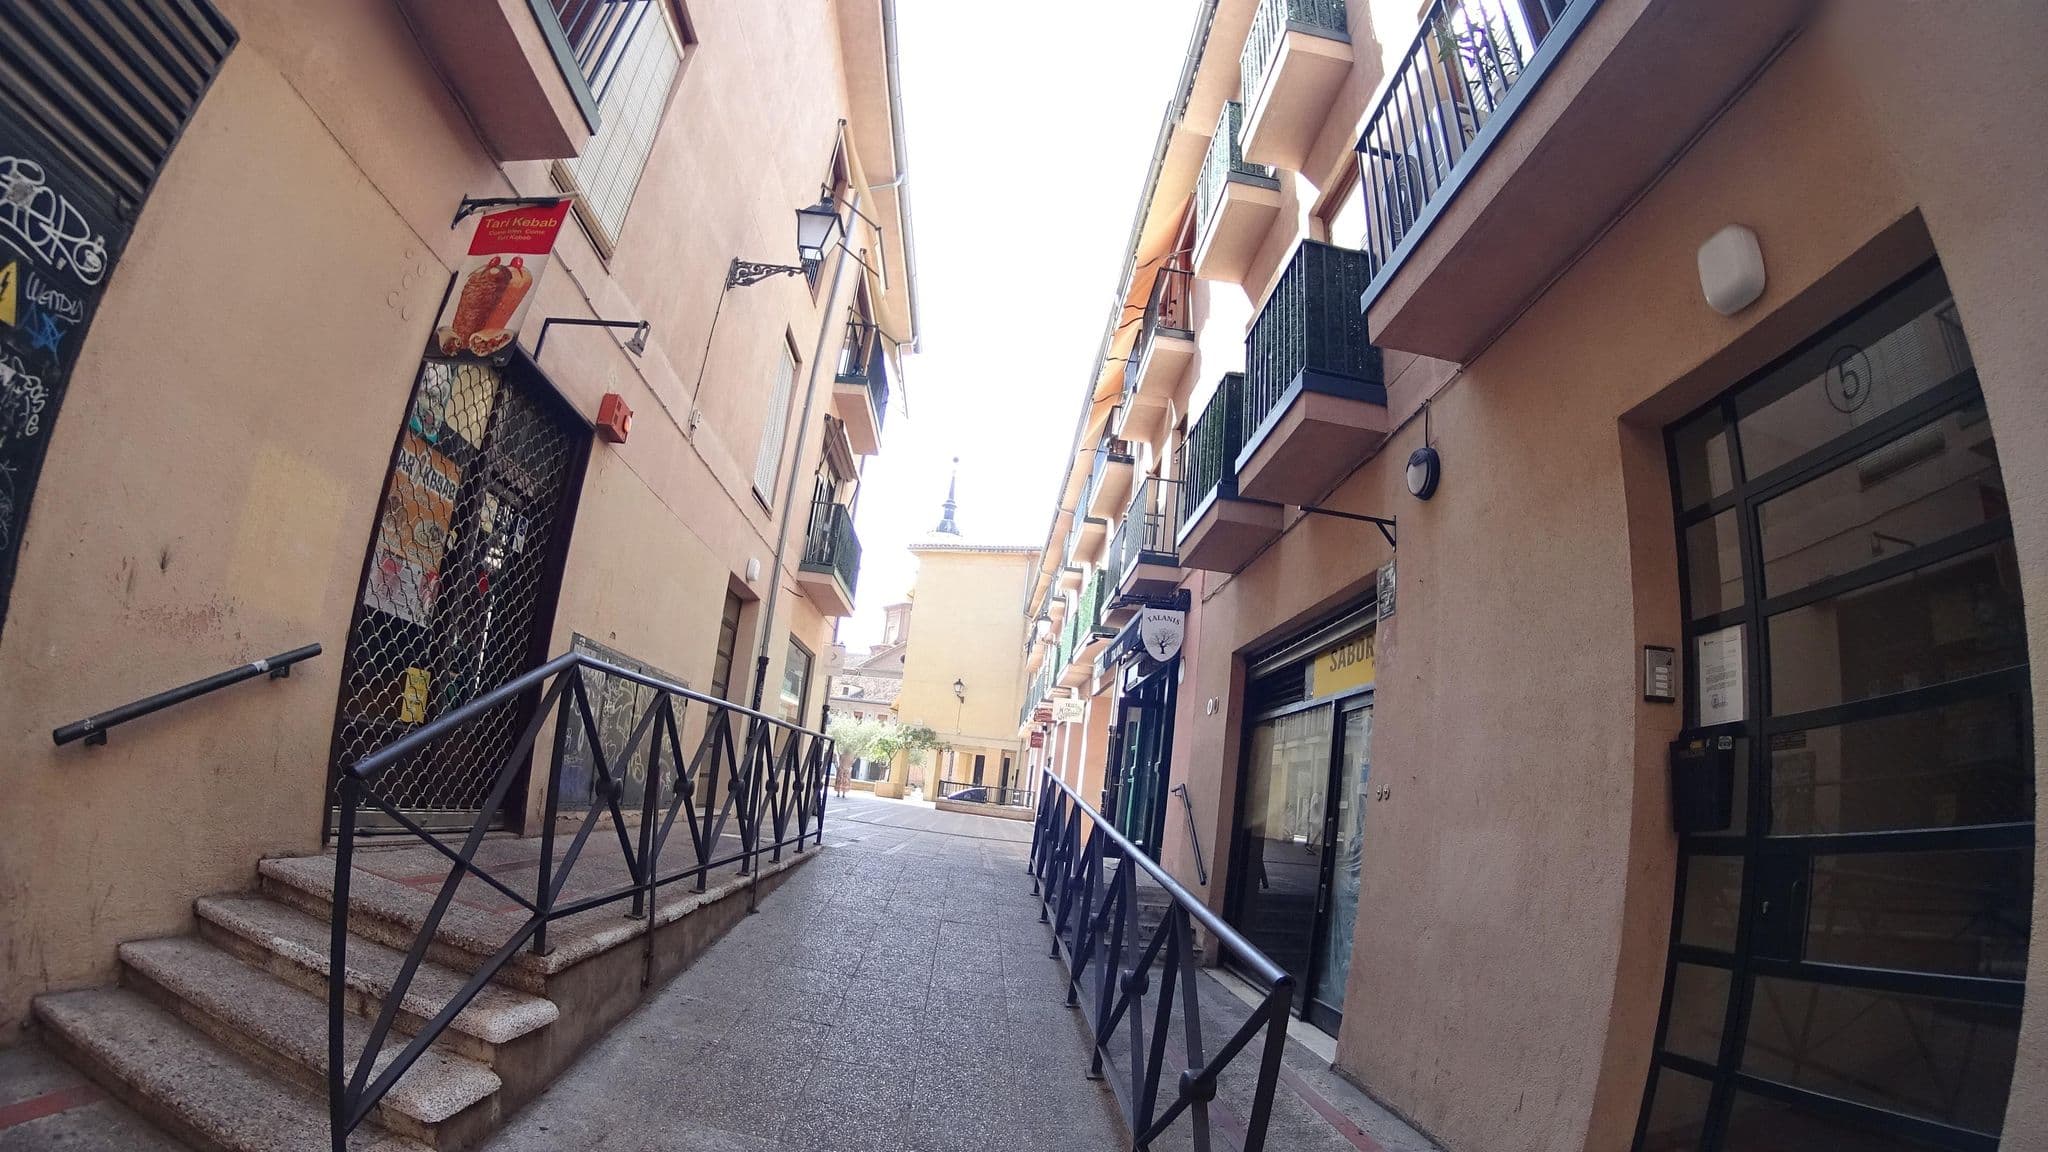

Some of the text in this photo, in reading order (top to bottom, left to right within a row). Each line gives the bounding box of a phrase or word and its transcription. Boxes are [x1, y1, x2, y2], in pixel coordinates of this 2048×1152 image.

[485, 217, 558, 228] Tari Kebab
[1839, 355, 1859, 400] 5
[1147, 615, 1180, 625] TALANIS
